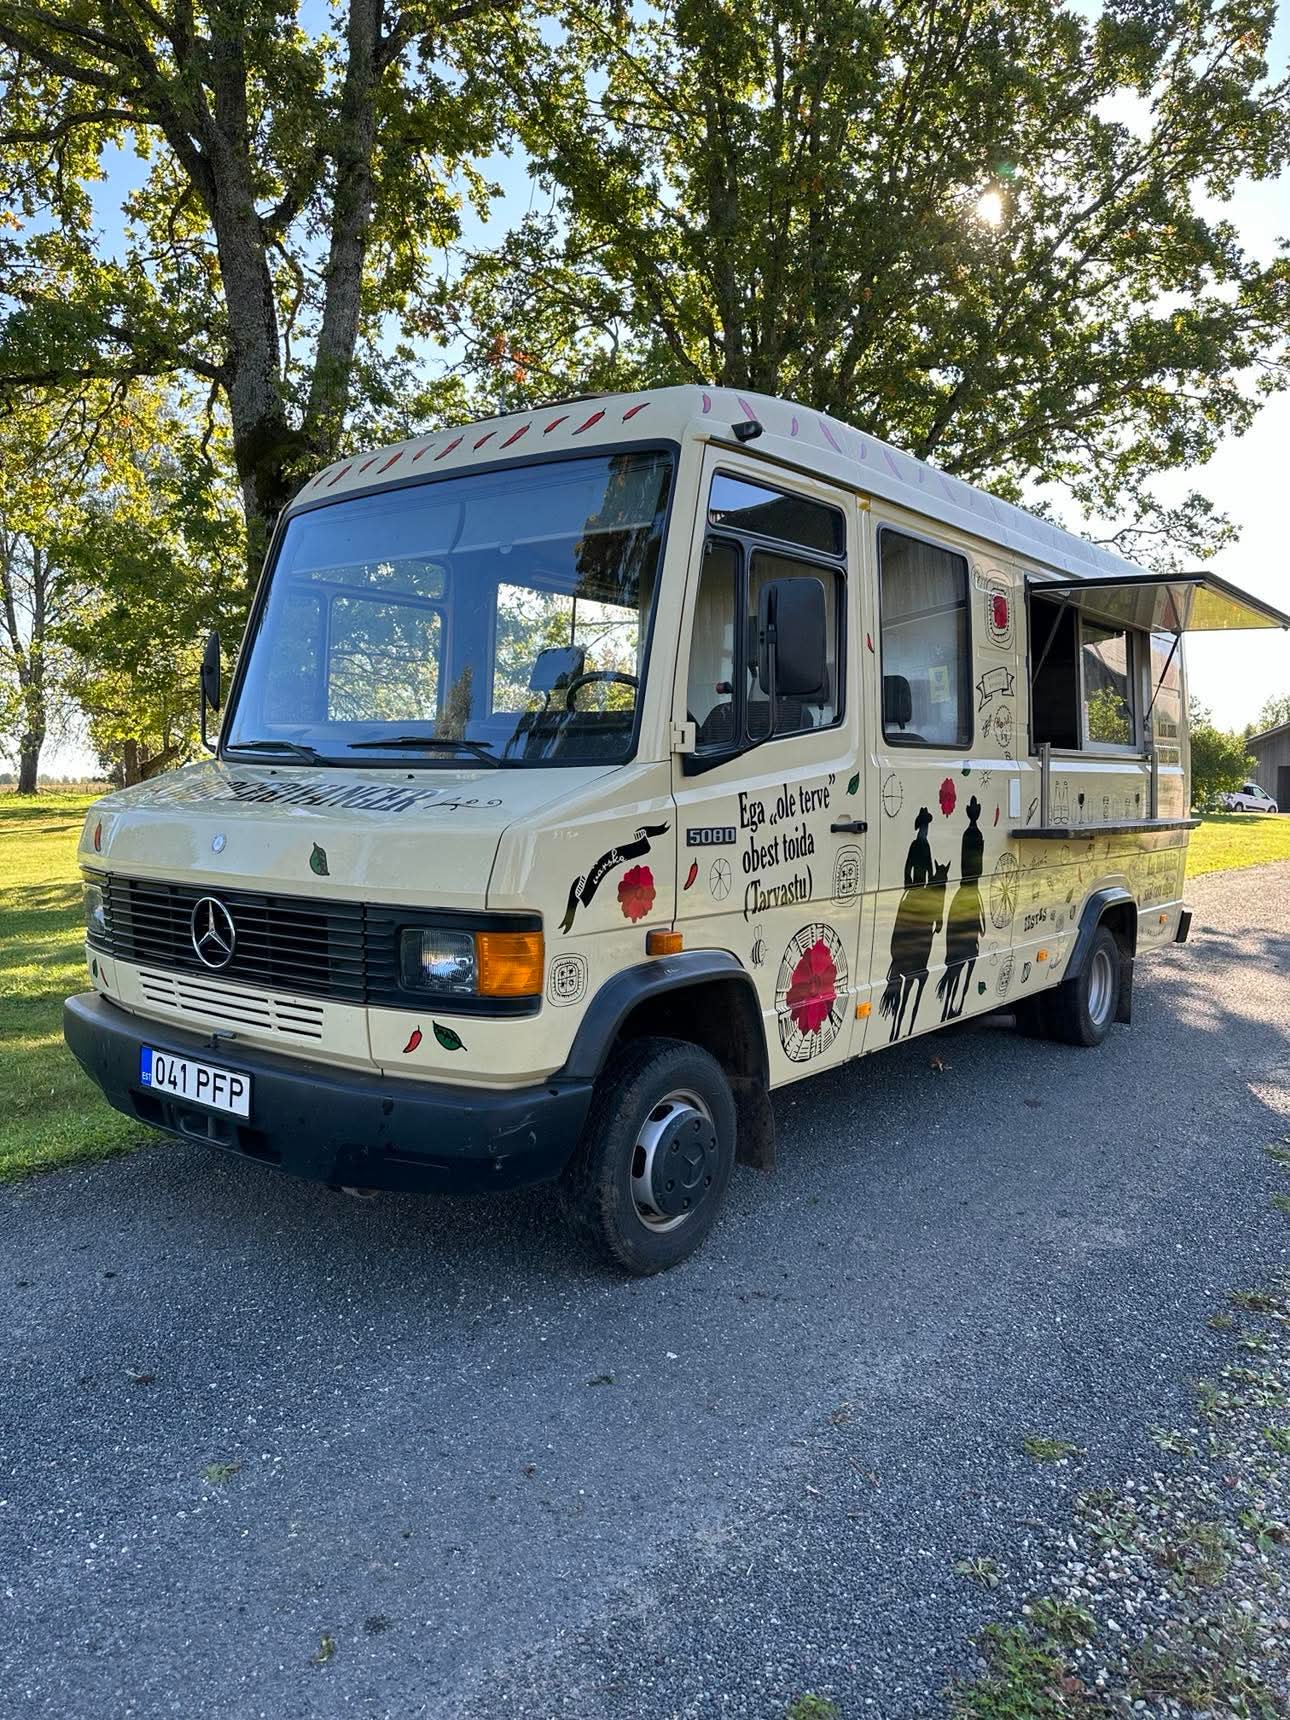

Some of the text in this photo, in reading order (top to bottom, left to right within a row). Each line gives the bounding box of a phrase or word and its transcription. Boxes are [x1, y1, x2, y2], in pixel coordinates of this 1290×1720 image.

[738, 791, 765, 833] Ega
[689, 828, 735, 844] 508D
[743, 822, 815, 874] obest toida
[744, 865, 813, 922] (Tarvastu)
[142, 1071, 152, 1080] EST
[156, 1057, 243, 1107] 041 PFP
